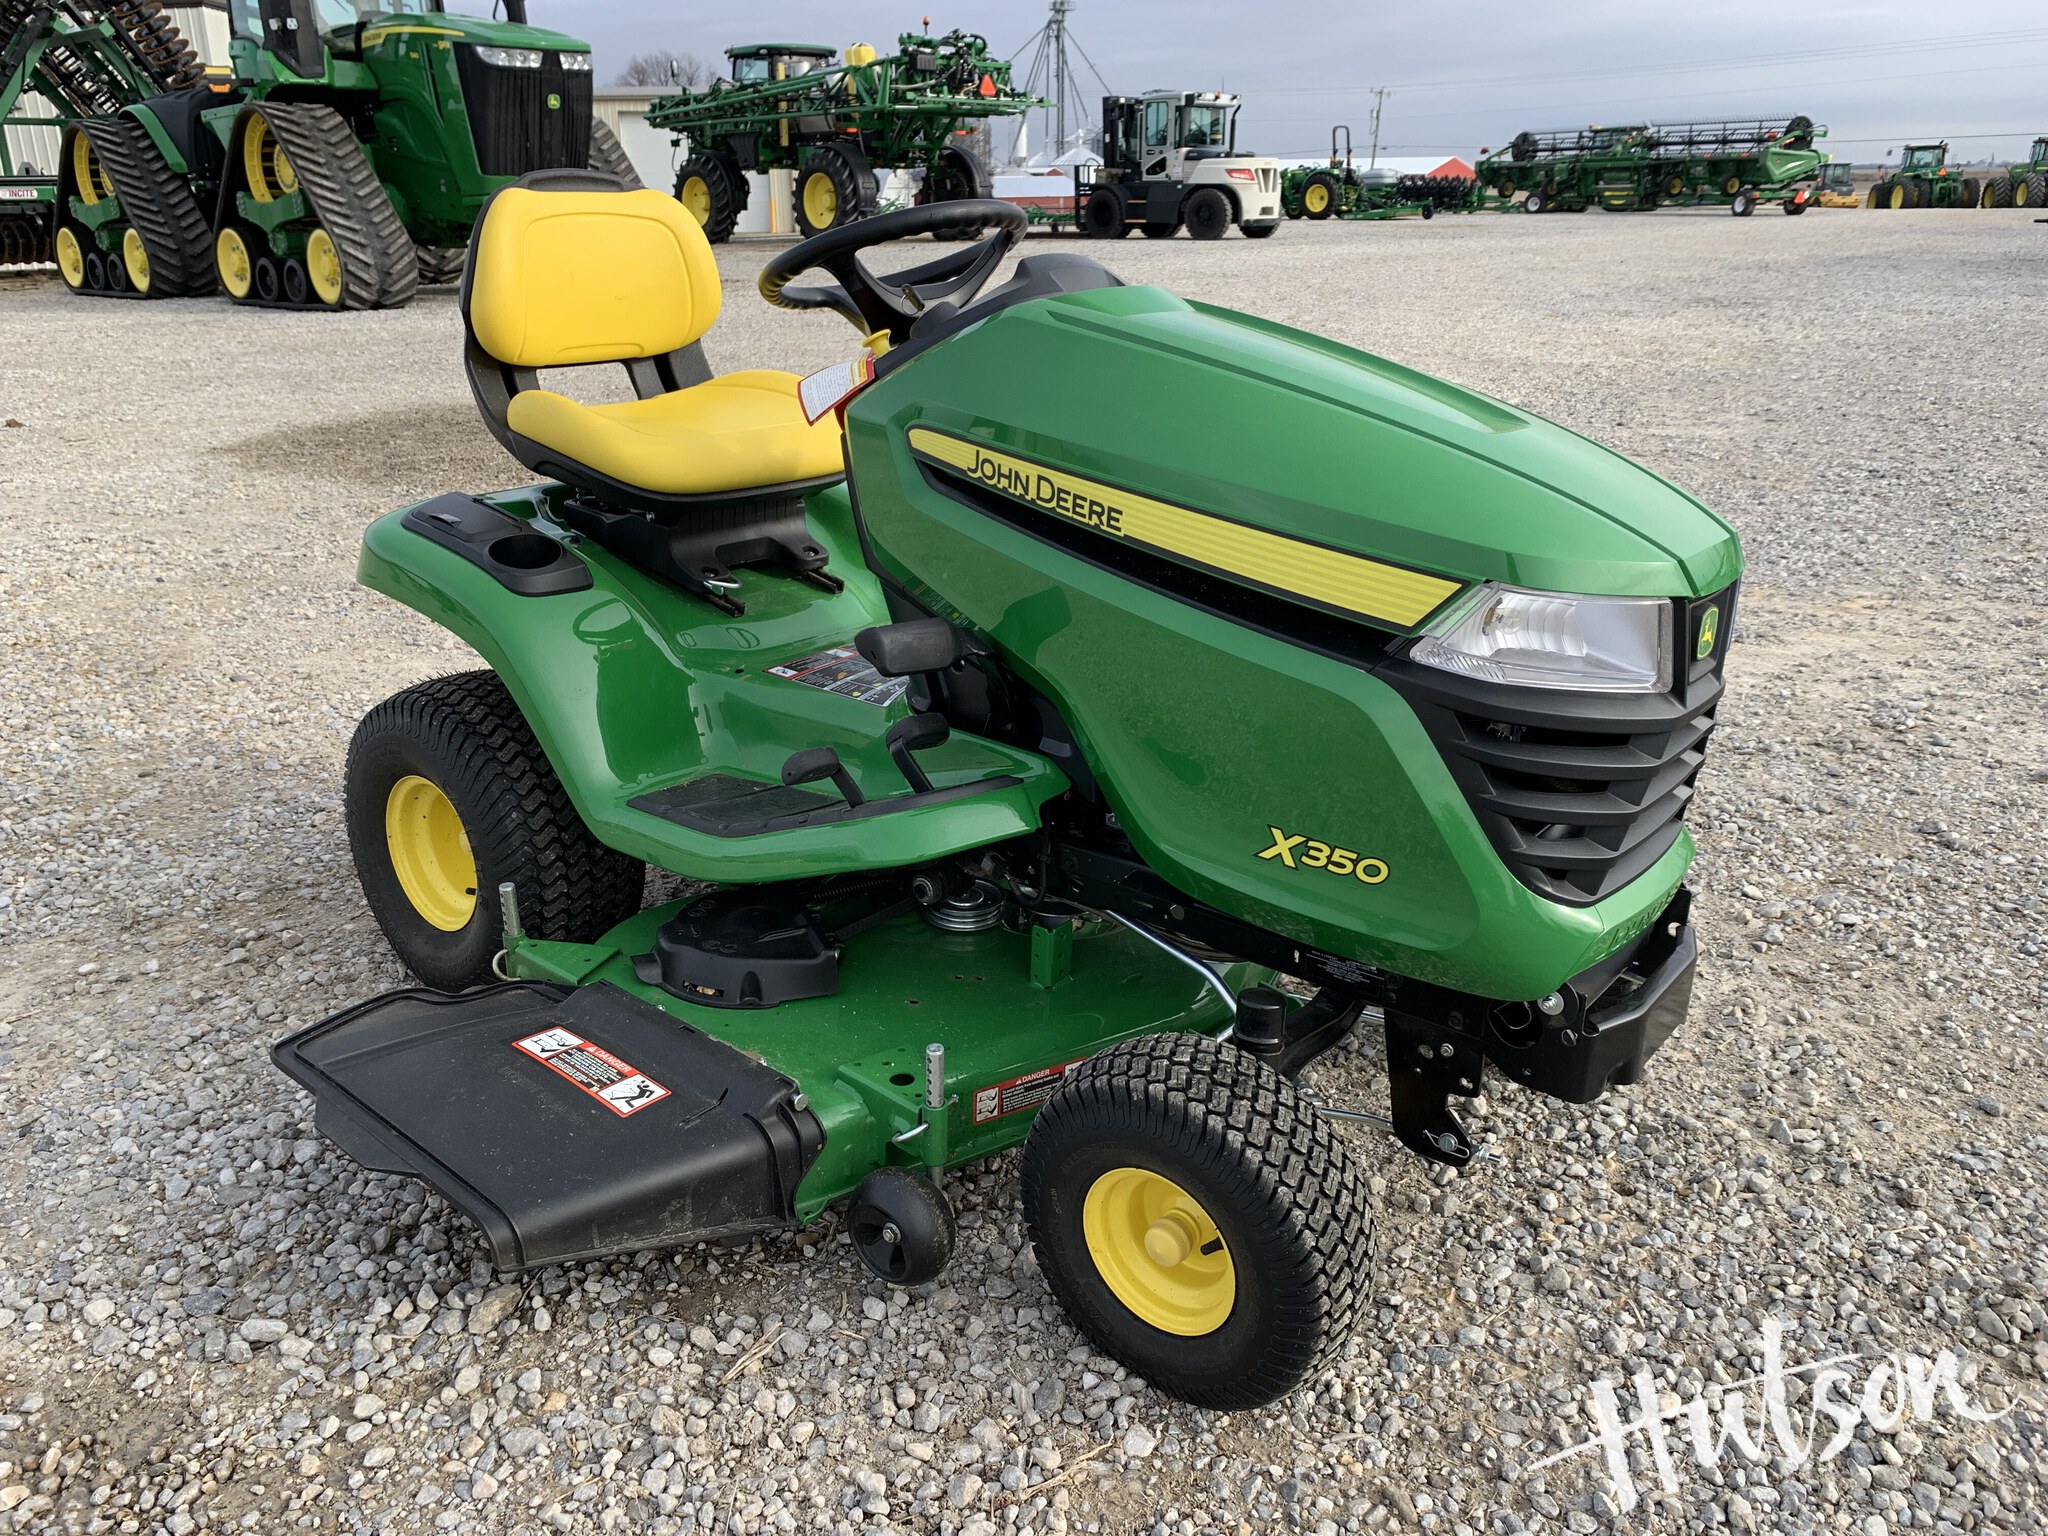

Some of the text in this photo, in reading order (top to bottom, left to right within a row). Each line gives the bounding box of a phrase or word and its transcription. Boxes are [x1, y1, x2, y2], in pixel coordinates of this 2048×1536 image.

[9, 189, 35, 197] INCITE
[967, 450, 1124, 533] JOHN DEERE
[1254, 825, 1390, 885] X350
[595, 1050, 633, 1073] DANGER
[1022, 1069, 1050, 1083] DANGER
